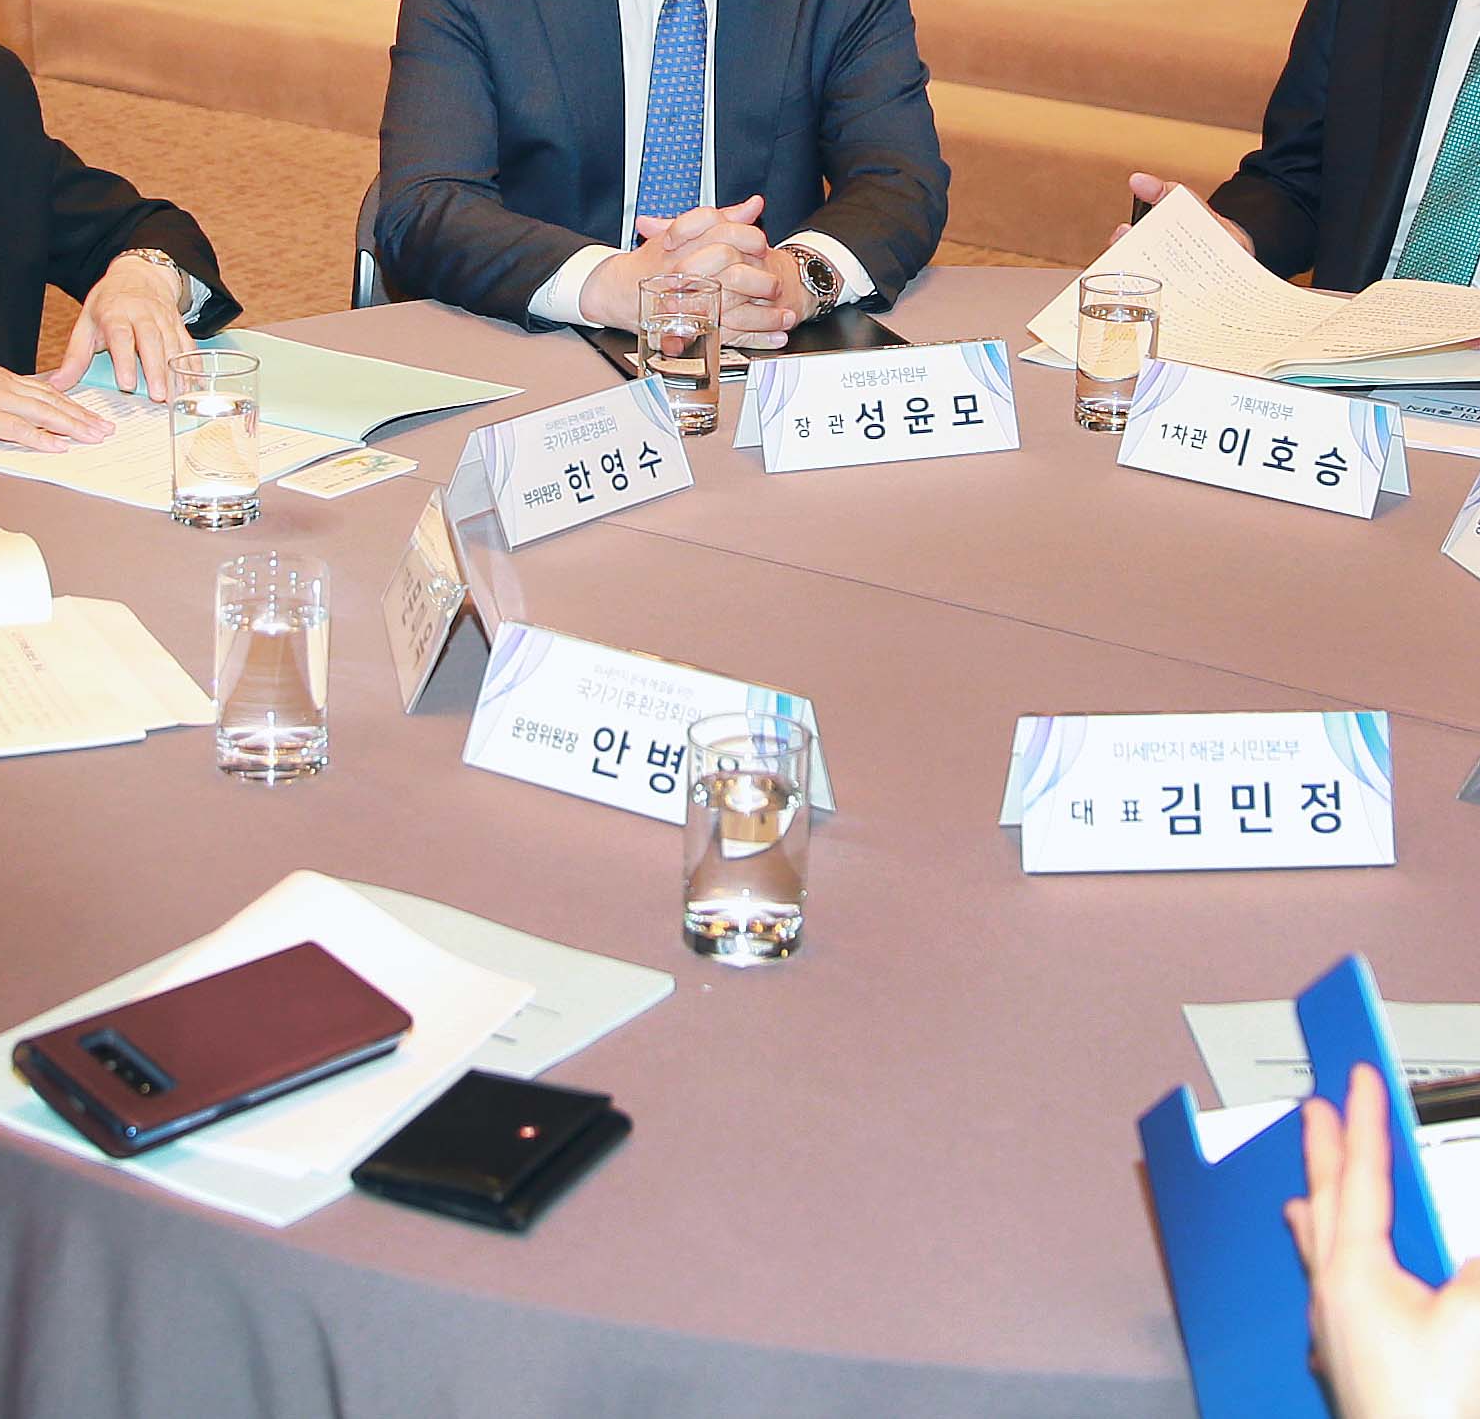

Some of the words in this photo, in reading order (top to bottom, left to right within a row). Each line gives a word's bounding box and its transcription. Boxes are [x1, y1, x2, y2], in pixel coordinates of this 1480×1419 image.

[840, 365, 929, 389] 산업통상자원부
[1230, 393, 1295, 422] 기획재정부
[543, 413, 618, 452] 국가기후환경회의
[1160, 423, 1208, 450] 1차관
[523, 481, 562, 509] 부위원장
[511, 716, 579, 754] 운영위원장
[1112, 740, 1186, 763] 미세먼지
[1189, 740, 1226, 763] 해결
[1230, 739, 1301, 762] 시민본부
